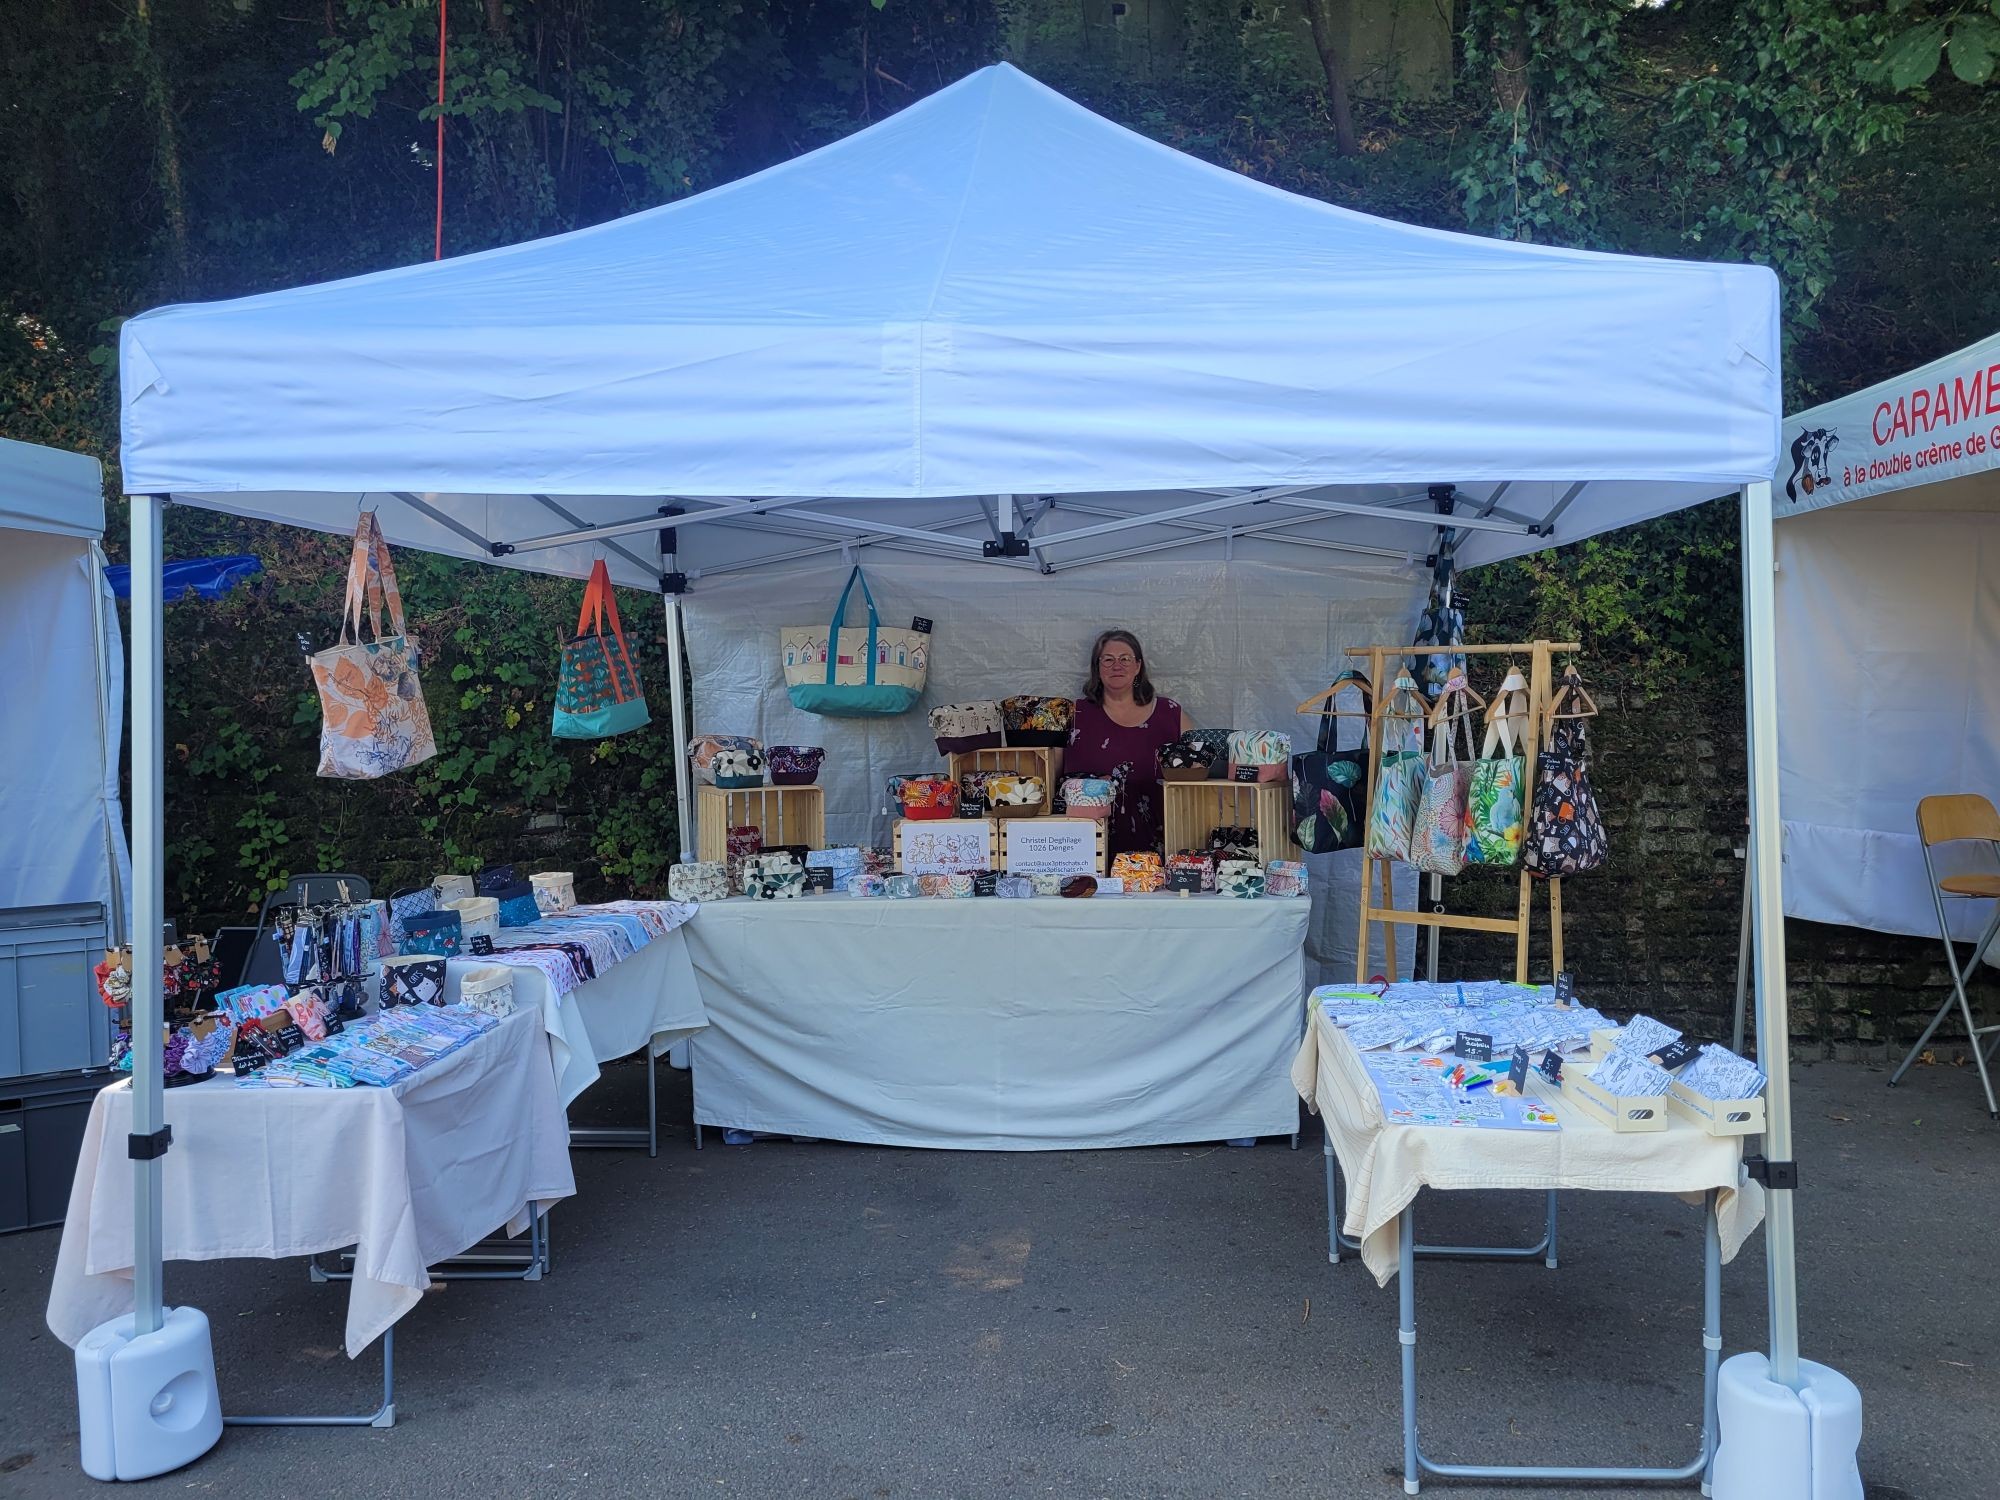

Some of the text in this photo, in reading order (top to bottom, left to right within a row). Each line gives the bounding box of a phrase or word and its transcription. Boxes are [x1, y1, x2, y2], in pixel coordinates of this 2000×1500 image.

[1873, 364, 2000, 446] CARAME
[1844, 466, 1851, 487] à
[1855, 464, 1866, 484] la
[1869, 451, 1912, 479] double
[1915, 441, 1962, 469] crème
[1966, 432, 1986, 456] de
[1020, 836, 1047, 844] Christel
[1029, 844, 1075, 853] 1026 Denges
